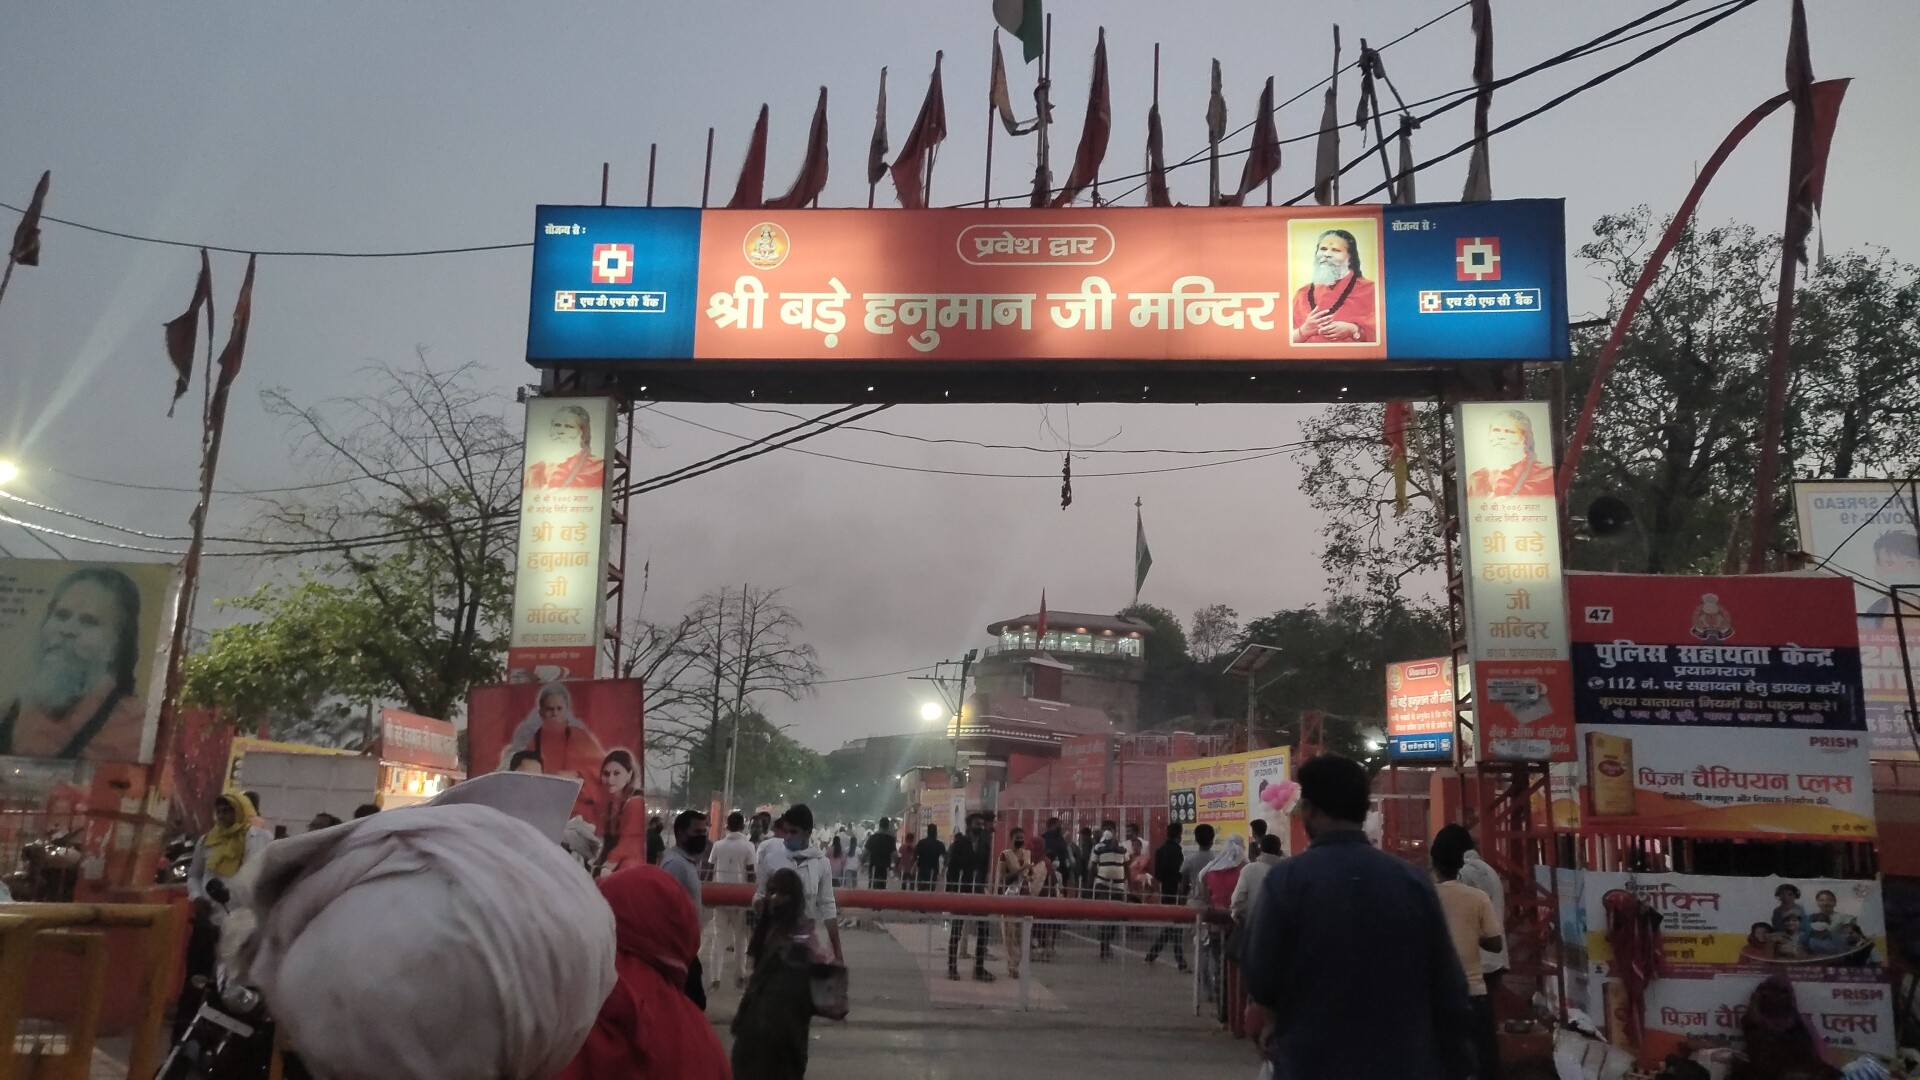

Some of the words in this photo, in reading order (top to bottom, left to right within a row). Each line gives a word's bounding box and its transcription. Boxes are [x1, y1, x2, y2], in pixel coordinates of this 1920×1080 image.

[974, 232, 1041, 257] प्रवेश
[1048, 236, 1097, 256] द्वार
[580, 296, 595, 308] एच
[596, 294, 608, 307] डी
[609, 296, 625, 308] एफ
[642, 294, 660, 308] बैंक
[1446, 297, 1462, 309] एच
[1463, 293, 1477, 307] डी
[1478, 296, 1496, 308] एफ
[1497, 293, 1511, 306] सी
[1515, 291, 1533, 305] बैंक
[705, 275, 769, 329] श्री
[779, 277, 851, 348] बड़े
[862, 293, 1036, 352] हनुमान
[1047, 276, 1117, 329] जी
[1128, 276, 1280, 330] मन्दिर
[531, 522, 553, 543] श्री
[1482, 531, 1507, 554] श्री
[1515, 531, 1546, 557] बड़े
[527, 551, 590, 572] हनुमान
[1481, 563, 1550, 584] हनुमान
[545, 576, 568, 596] जी
[1505, 588, 1531, 610] जी
[527, 603, 583, 624] मन्दिर
[1589, 609, 1611, 621] 47
[1489, 616, 1550, 640] मन्दिर
[1595, 639, 1668, 669] पुलिस
[1675, 645, 1771, 665] सहायता
[1779, 642, 1834, 667] केन्द्र
[1673, 666, 1756, 677] प्रयागराज
[1608, 677, 1636, 690] 112
[1664, 681, 1683, 691] पर
[1686, 681, 1741, 692] सहायता
[1744, 680, 1768, 697] हेतु
[1771, 683, 1812, 694] डायल
[1599, 697, 1637, 710] कृपया
[1641, 698, 1695, 708] यातायात
[1699, 696, 1742, 709] नियमों
[1744, 699, 1763, 710] का
[1767, 700, 1805, 711] पालन
[1809, 736, 1859, 748] PRISM
[1692, 764, 1790, 792] चैम्पियन
[1796, 773, 1854, 794] प्लस
[1229, 800, 1236, 808] 19
[1832, 988, 1884, 1001] PRISM
[1821, 1013, 1878, 1033] प्लस
